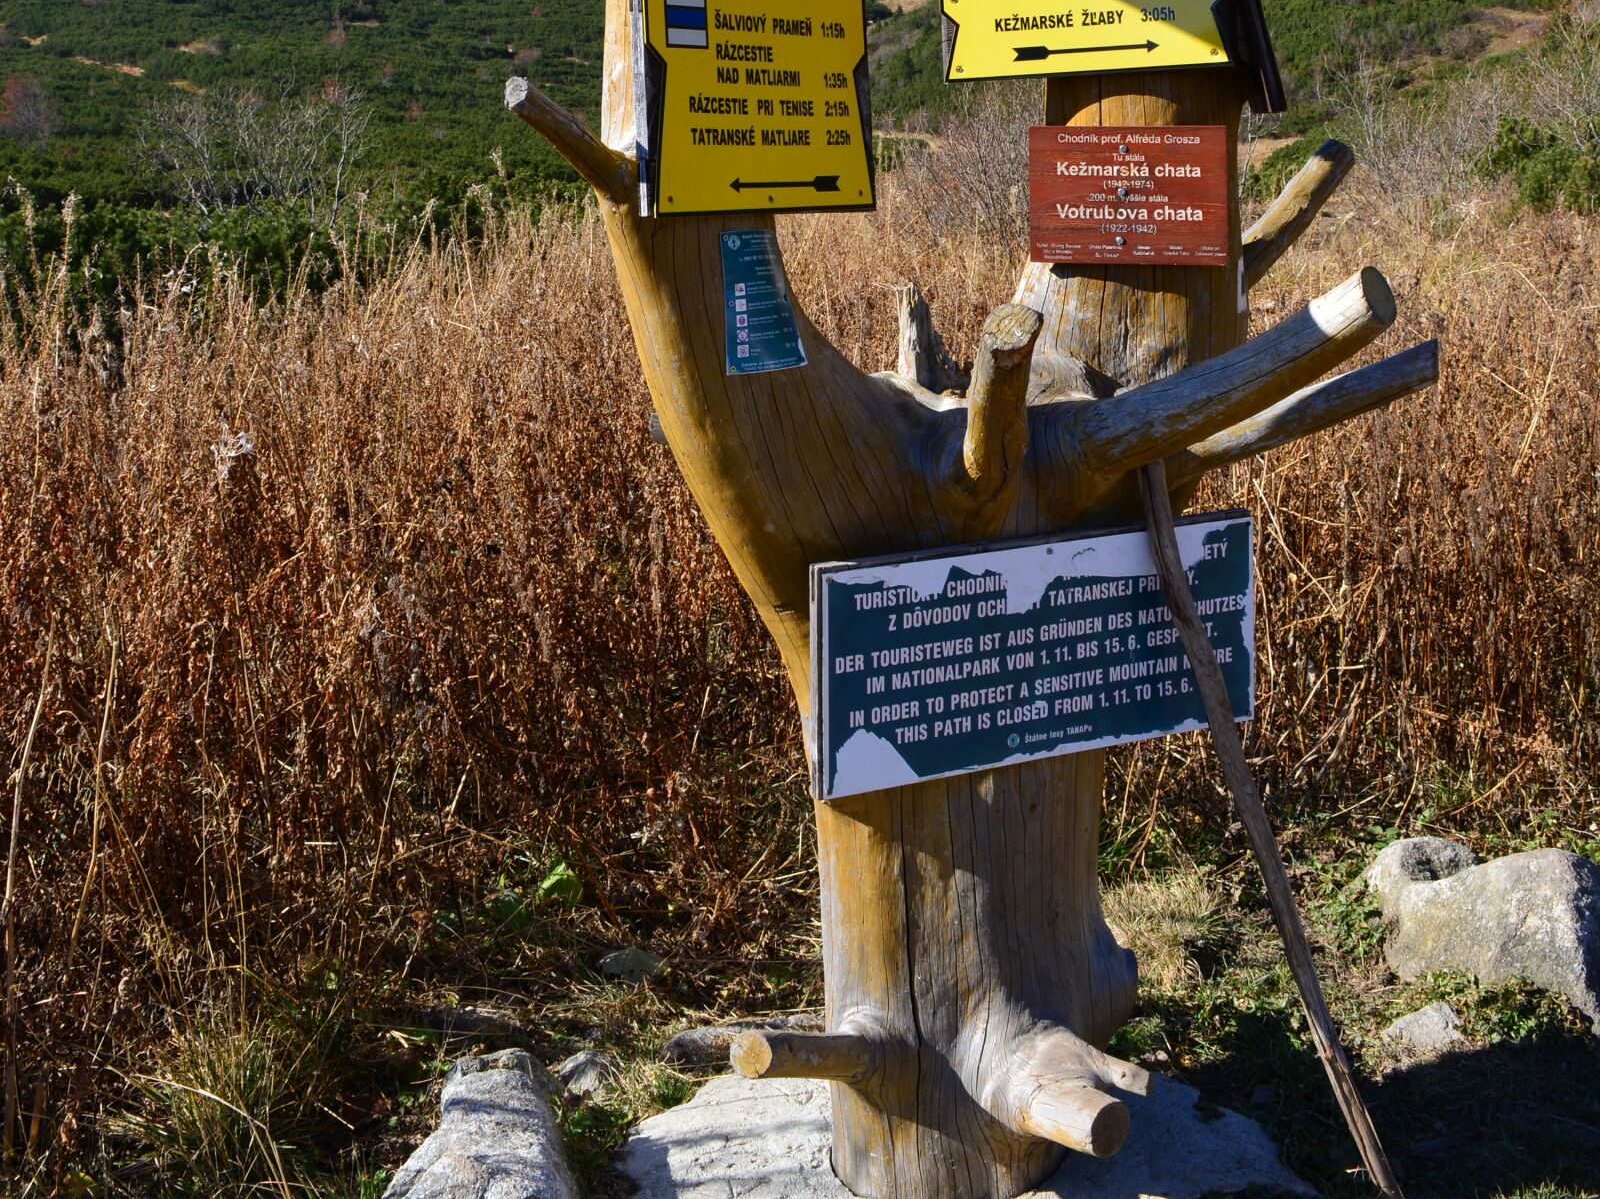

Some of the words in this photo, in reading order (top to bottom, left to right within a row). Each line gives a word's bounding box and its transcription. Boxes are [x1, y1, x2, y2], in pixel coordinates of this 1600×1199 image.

[714, 9, 766, 33] ŠALVIOVÝ
[773, 17, 812, 37] PRAMEŇ
[821, 22, 845, 39] 1:15h
[994, 10, 1074, 32] KEŽMARSKÉ
[1081, 9, 1124, 27] ŽĽABY
[1140, 6, 1176, 22] 3:05h
[716, 41, 773, 63] RÁZCESTIE
[717, 67, 739, 84] NAD
[745, 68, 800, 87] MATLIARMI
[823, 72, 848, 88] 1:35h
[689, 93, 748, 115] RÁZCESTIE
[757, 100, 774, 116] PRI
[779, 101, 814, 117] TENISE
[825, 101, 849, 117] 2:15h
[691, 126, 755, 146] TATRANSKÉ
[761, 129, 810, 146] MATLIARE
[826, 130, 851, 146] 2:25h
[1057, 134, 1099, 144] Chodník
[1101, 134, 1124, 145] prof.
[1126, 134, 1161, 144] Alfréda
[1163, 135, 1200, 144] Grosza
[1056, 162, 1149, 177] Kežmarská
[1154, 164, 1201, 178] chata
[1103, 180, 1154, 189] (1942-1974)
[1089, 194, 1106, 202] 200
[1056, 204, 1148, 220] Votrubova
[1153, 206, 1203, 221] chata
[1101, 224, 1157, 234] (1922-1942)
[888, 614, 897, 632] Z
[903, 603, 972, 630] DÔVODOV
[1049, 579, 1133, 607] TATRANSKEJ
[835, 654, 865, 674] DER
[871, 637, 973, 669] TOURISTEWEG
[980, 633, 1002, 651] IST
[1007, 627, 1034, 648] AUS
[1040, 616, 1102, 641] GRÜNDEN
[1108, 611, 1133, 631] DES
[867, 676, 885, 695] IM
[892, 656, 1000, 690] NATIONALPARK
[1006, 651, 1034, 671] VON
[1077, 641, 1098, 659] BIS
[850, 710, 865, 728] IN
[871, 701, 920, 724] ORDER
[926, 696, 944, 715] TO
[951, 684, 1014, 710] PROTECT
[1020, 683, 1029, 698] A
[1035, 669, 1103, 696] SENSITIVE
[1109, 656, 1177, 683] MOUNTAIN
[895, 723, 928, 744] THIS
[934, 716, 971, 738] PATH
[977, 712, 991, 730] IS
[997, 701, 1048, 726] CLOSED
[1055, 695, 1093, 716] FROM
[1135, 684, 1151, 701] TO
[1024, 733, 1047, 744] Štátne
[1050, 730, 1064, 741] lesy
